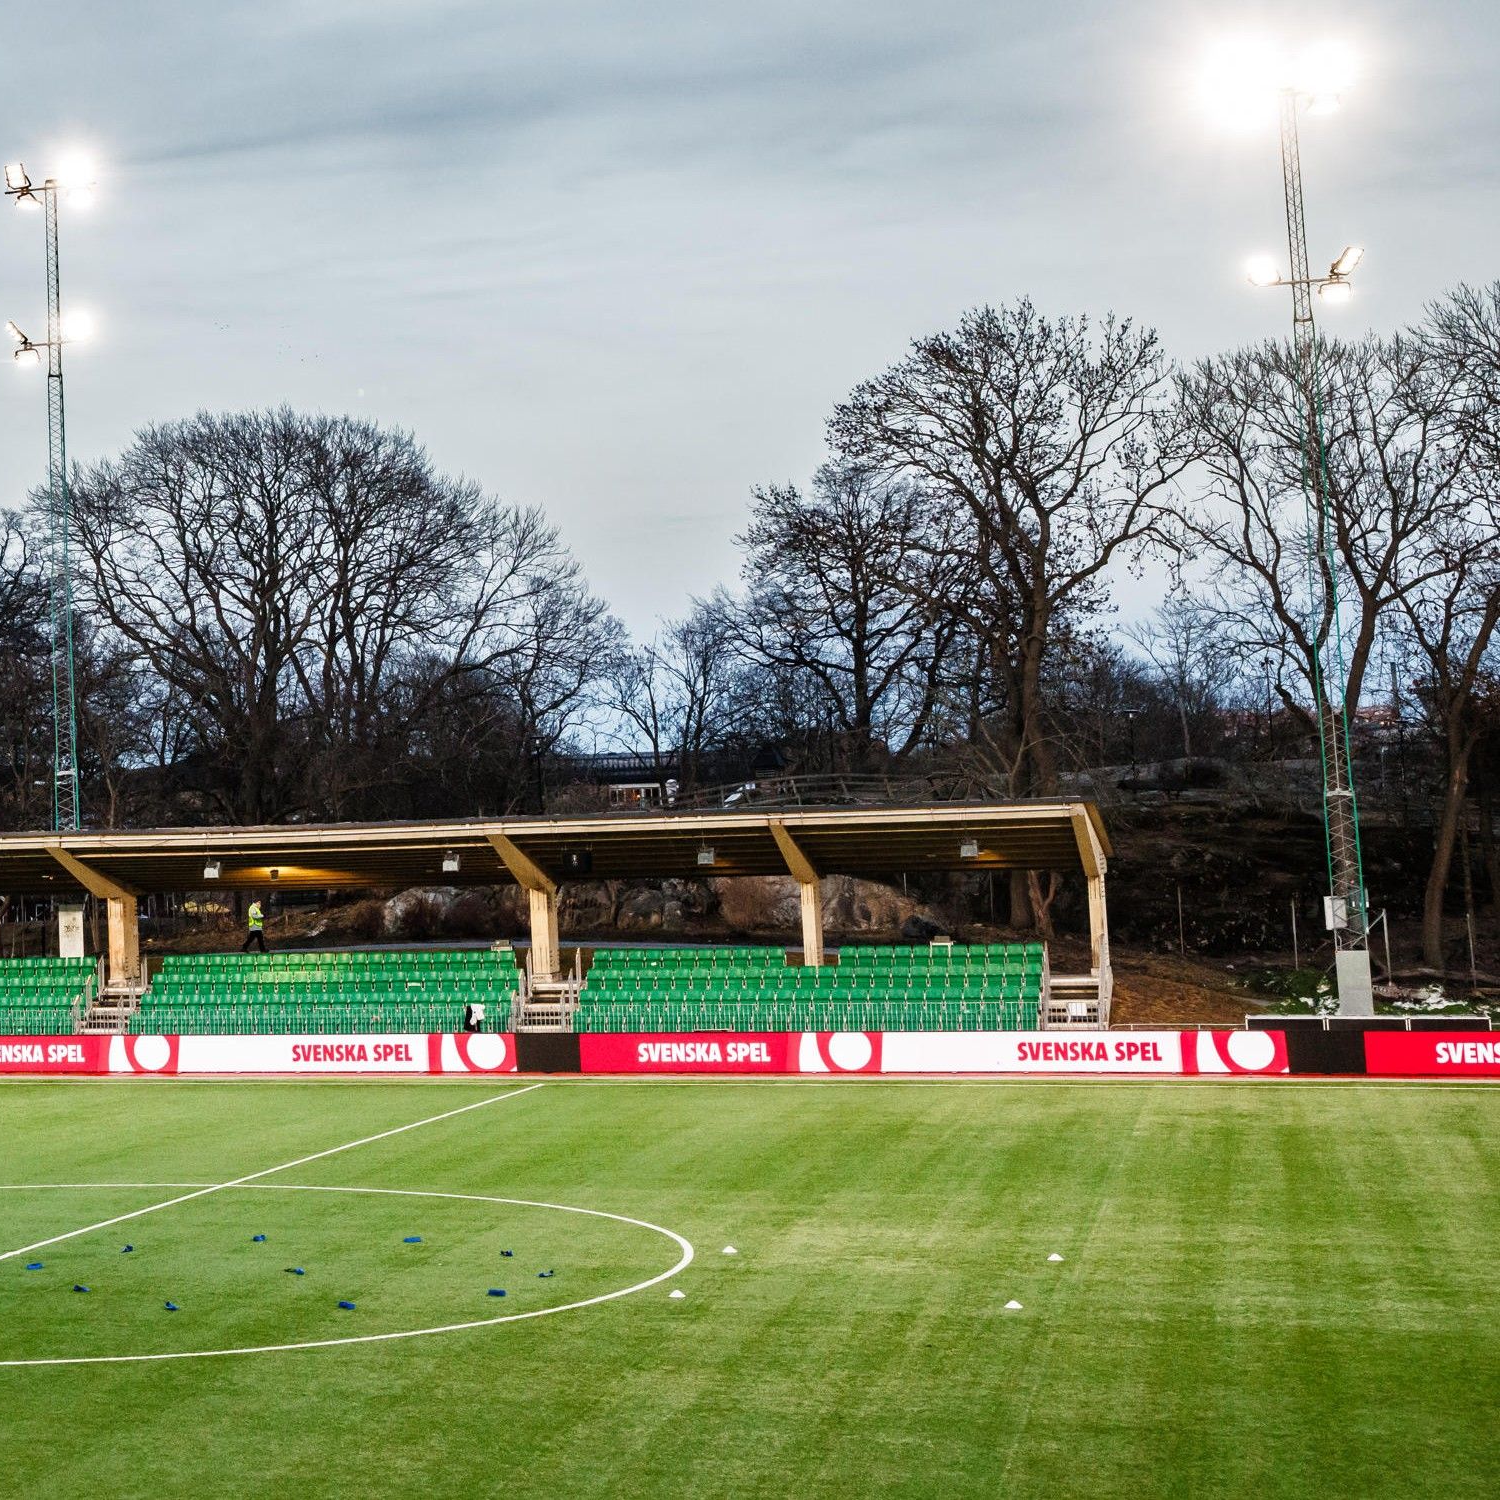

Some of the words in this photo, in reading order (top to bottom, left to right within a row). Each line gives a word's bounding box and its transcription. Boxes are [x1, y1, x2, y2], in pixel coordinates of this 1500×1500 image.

[47, 1044, 86, 1063] SPEL
[292, 1044, 368, 1063] SVENSKA
[372, 1043, 414, 1062] SPEL
[637, 1043, 723, 1063] SVENSKA
[726, 1043, 771, 1063] SPEL
[1017, 1042, 1109, 1062] SVENSKA
[1114, 1042, 1163, 1062] SPEL
